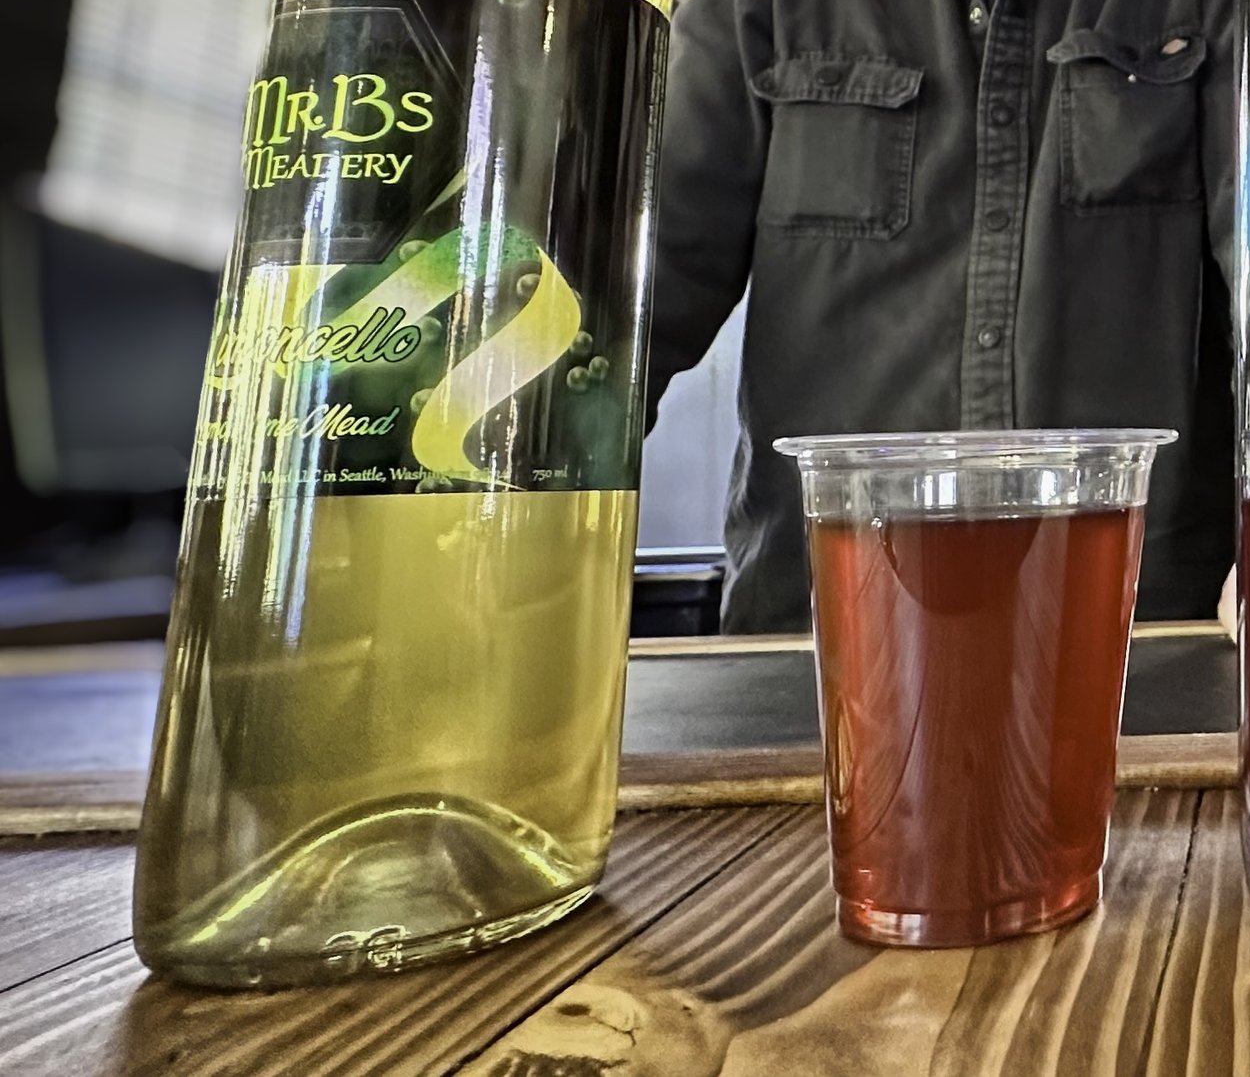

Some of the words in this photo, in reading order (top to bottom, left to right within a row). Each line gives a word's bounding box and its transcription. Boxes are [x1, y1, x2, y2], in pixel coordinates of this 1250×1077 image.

[299, 403, 400, 440] Mead
[323, 470, 337, 483] in
[339, 465, 386, 484] Seattle,
[532, 468, 553, 482] 750
